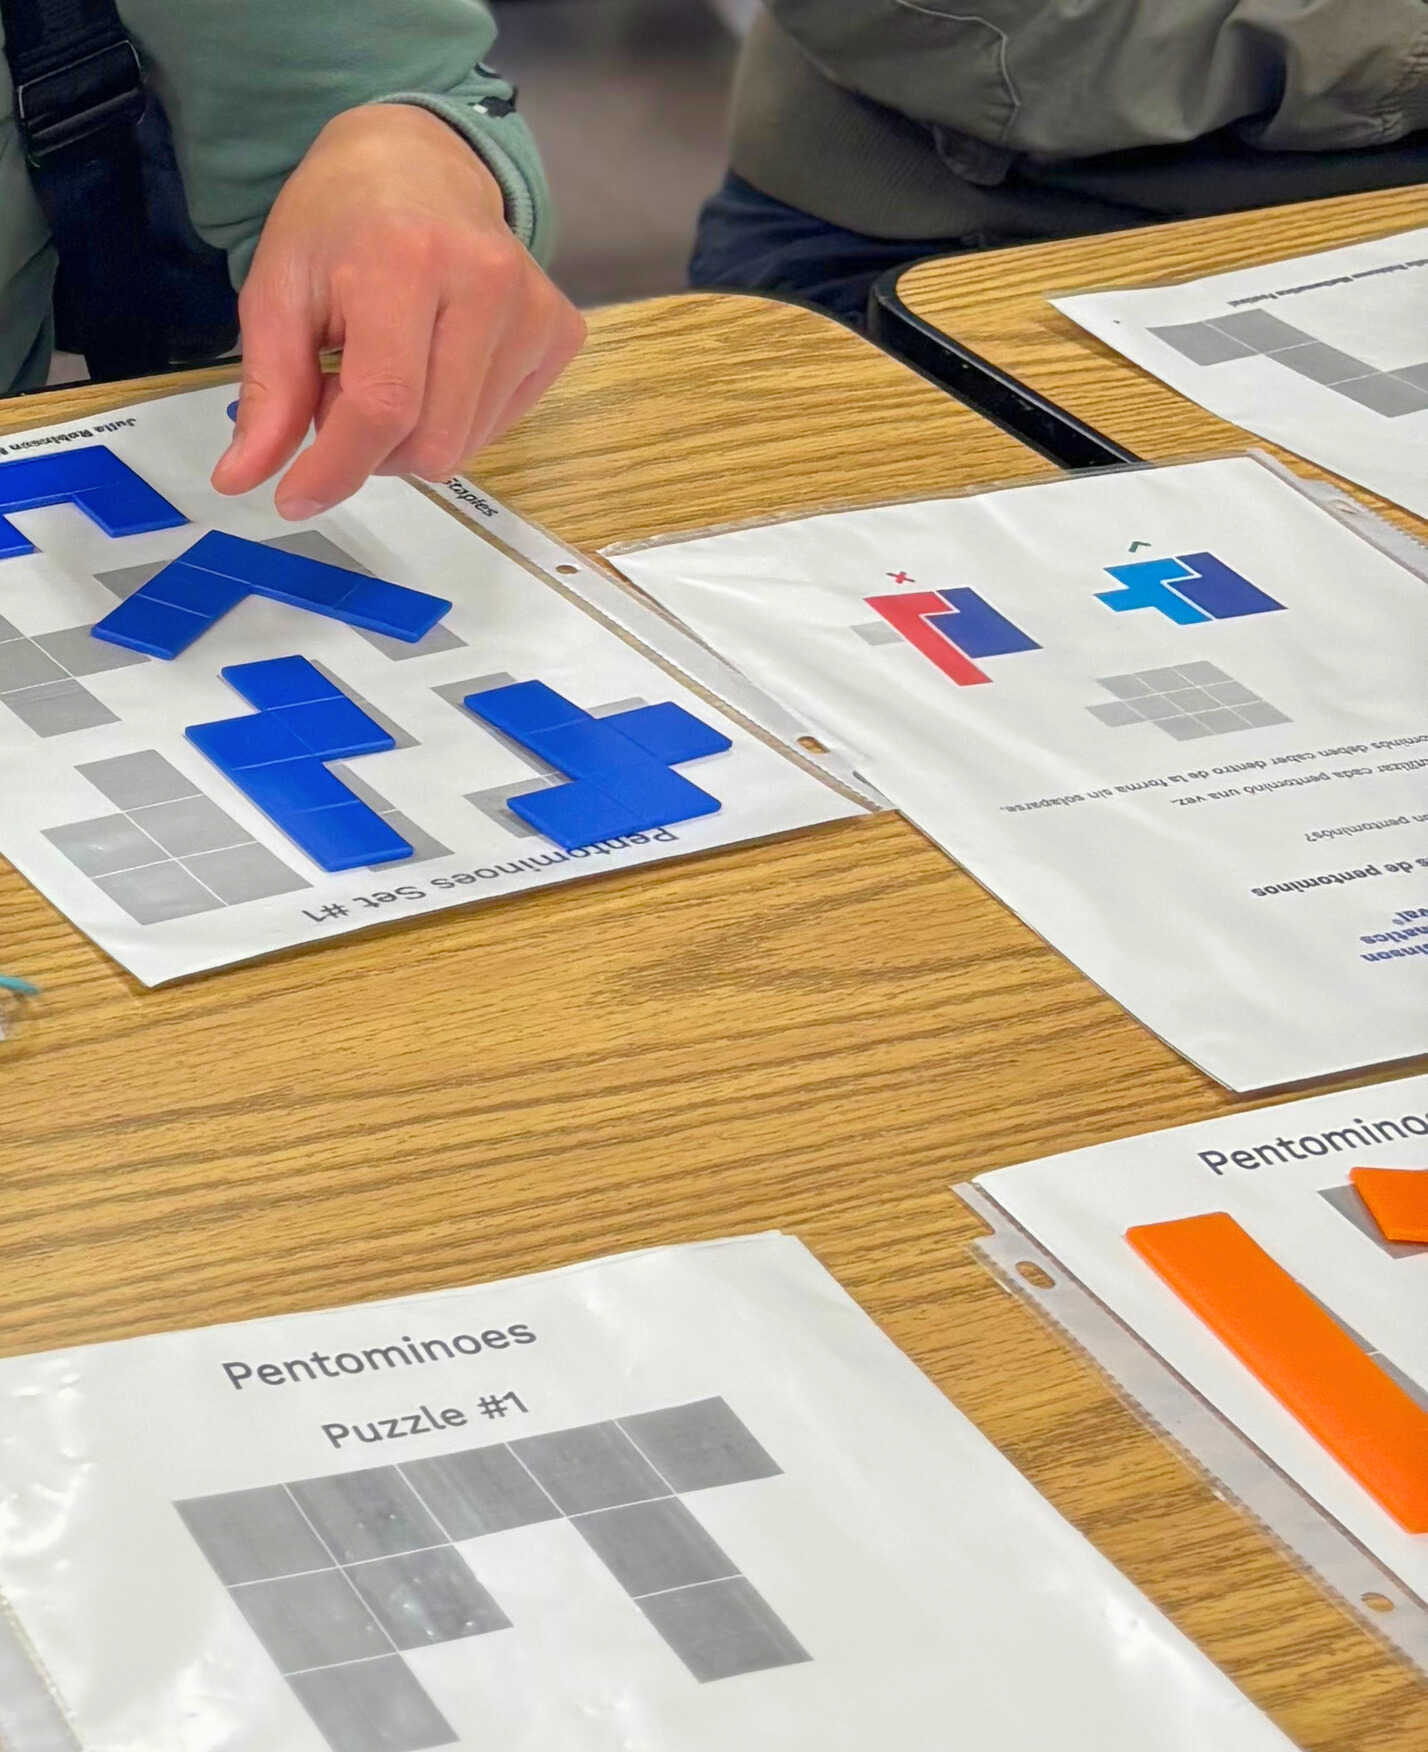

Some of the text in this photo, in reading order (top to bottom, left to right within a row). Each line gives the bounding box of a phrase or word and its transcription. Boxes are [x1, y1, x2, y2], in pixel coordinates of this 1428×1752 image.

[93, 417, 137, 436] Julia
[11, 430, 93, 453] Robinson
[1211, 759, 1267, 775] dentro
[1270, 751, 1317, 765] caber
[1114, 777, 1169, 793] forma
[1207, 788, 1242, 801] una
[302, 827, 680, 923] Pentominoes Set #1
[1383, 860, 1414, 874] de
[1251, 864, 1383, 897] pentominos
[1197, 1112, 1428, 1176] Pentomino
[221, 1322, 538, 1391] Pentominoes
[320, 1391, 530, 1449] Puzzle #1
